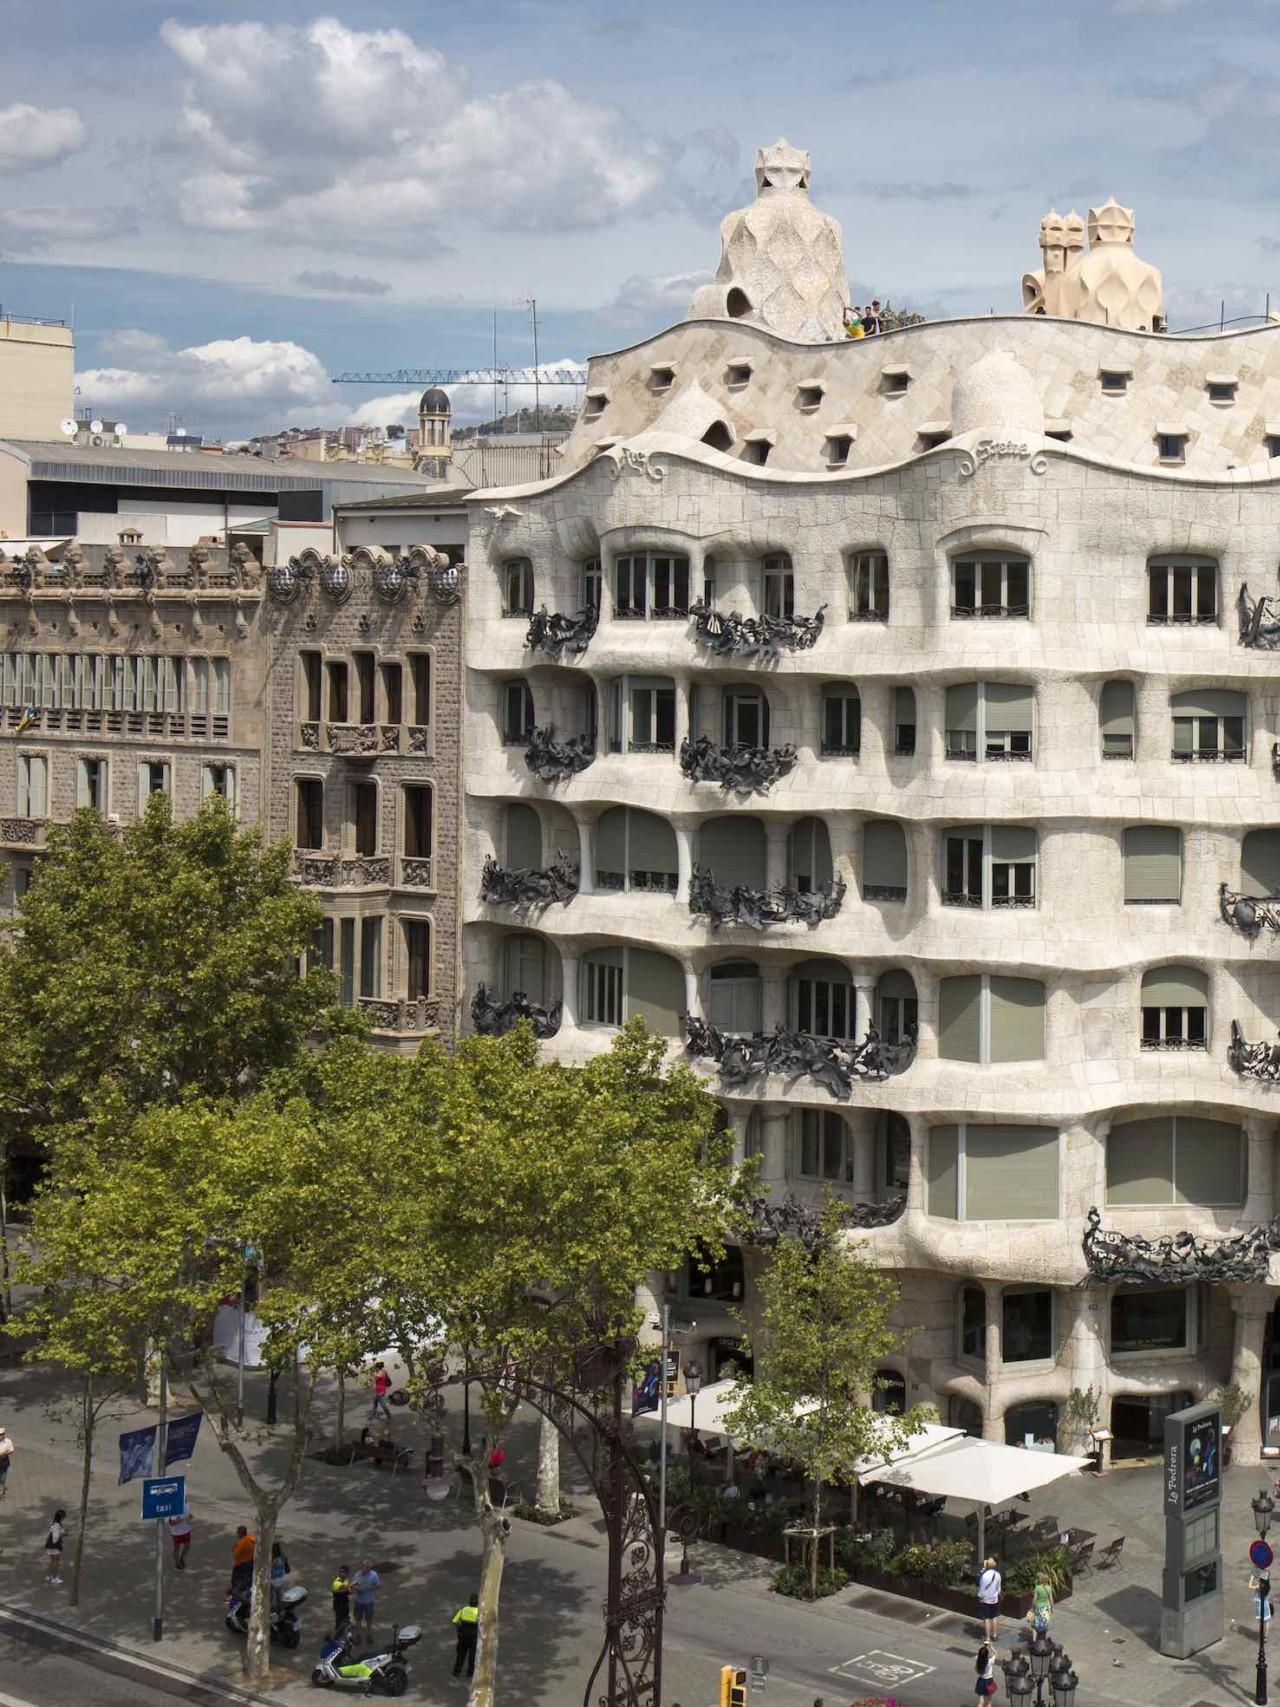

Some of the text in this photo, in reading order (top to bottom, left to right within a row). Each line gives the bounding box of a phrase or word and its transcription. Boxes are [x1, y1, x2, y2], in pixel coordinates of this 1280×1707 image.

[1168, 1446, 1179, 1504] La Pedrera
[156, 1504, 172, 1513] taxi
